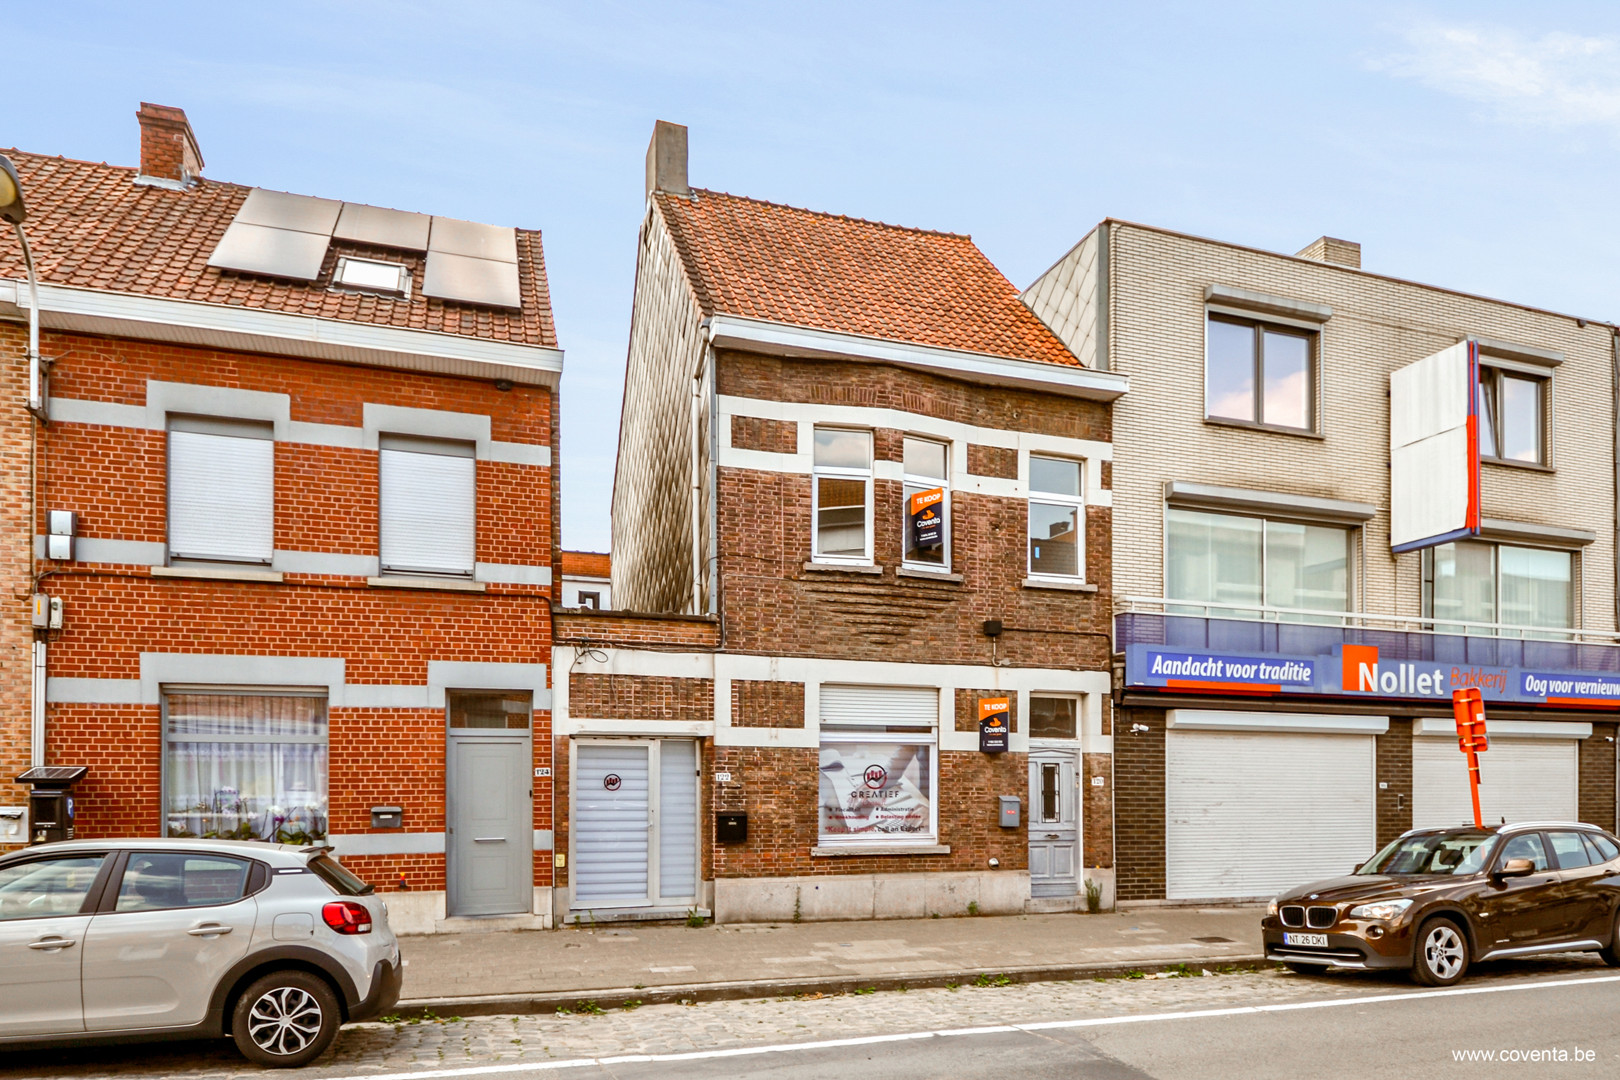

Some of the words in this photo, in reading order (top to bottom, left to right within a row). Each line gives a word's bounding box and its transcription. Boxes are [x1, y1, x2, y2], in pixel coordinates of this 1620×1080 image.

[924, 493, 941, 502] KOOP
[917, 517, 941, 527] Coventa
[1152, 655, 1223, 677] Aandacht
[1225, 665, 1257, 678] voor
[1259, 662, 1312, 681] traditie
[1359, 662, 1444, 695] Nollet
[1451, 667, 1508, 693] Bakkerij
[1525, 675, 1547, 696] Oog
[1548, 677, 1573, 694] voor
[1289, 935, 1298, 943] NT
[1301, 935, 1310, 944] 26
